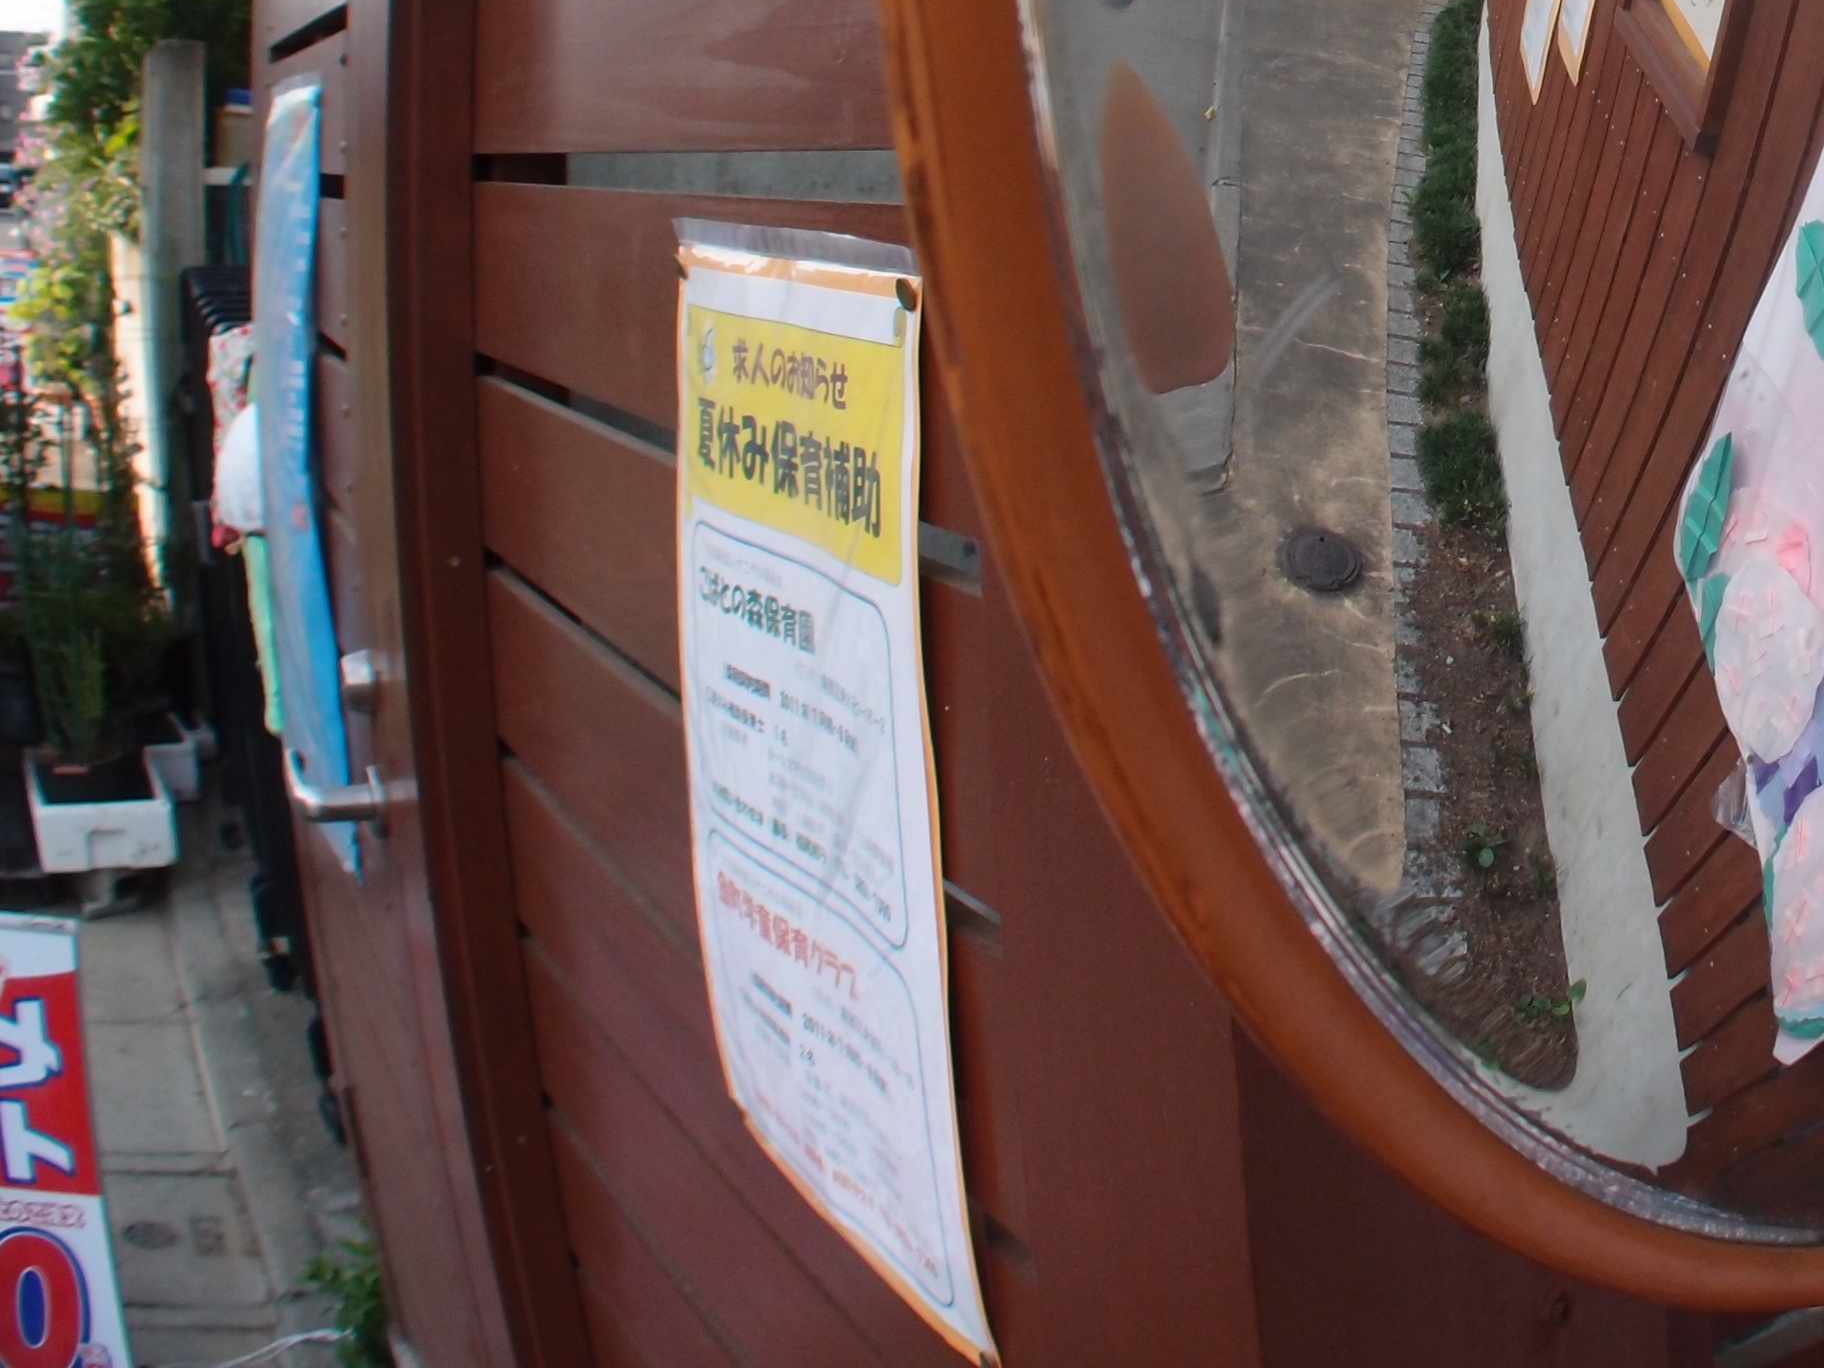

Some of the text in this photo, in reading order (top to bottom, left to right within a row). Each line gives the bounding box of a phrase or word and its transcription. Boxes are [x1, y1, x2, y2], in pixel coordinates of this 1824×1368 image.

[731, 337, 848, 410] 求人のお知らせ
[697, 397, 882, 538] 夏休み保育補助
